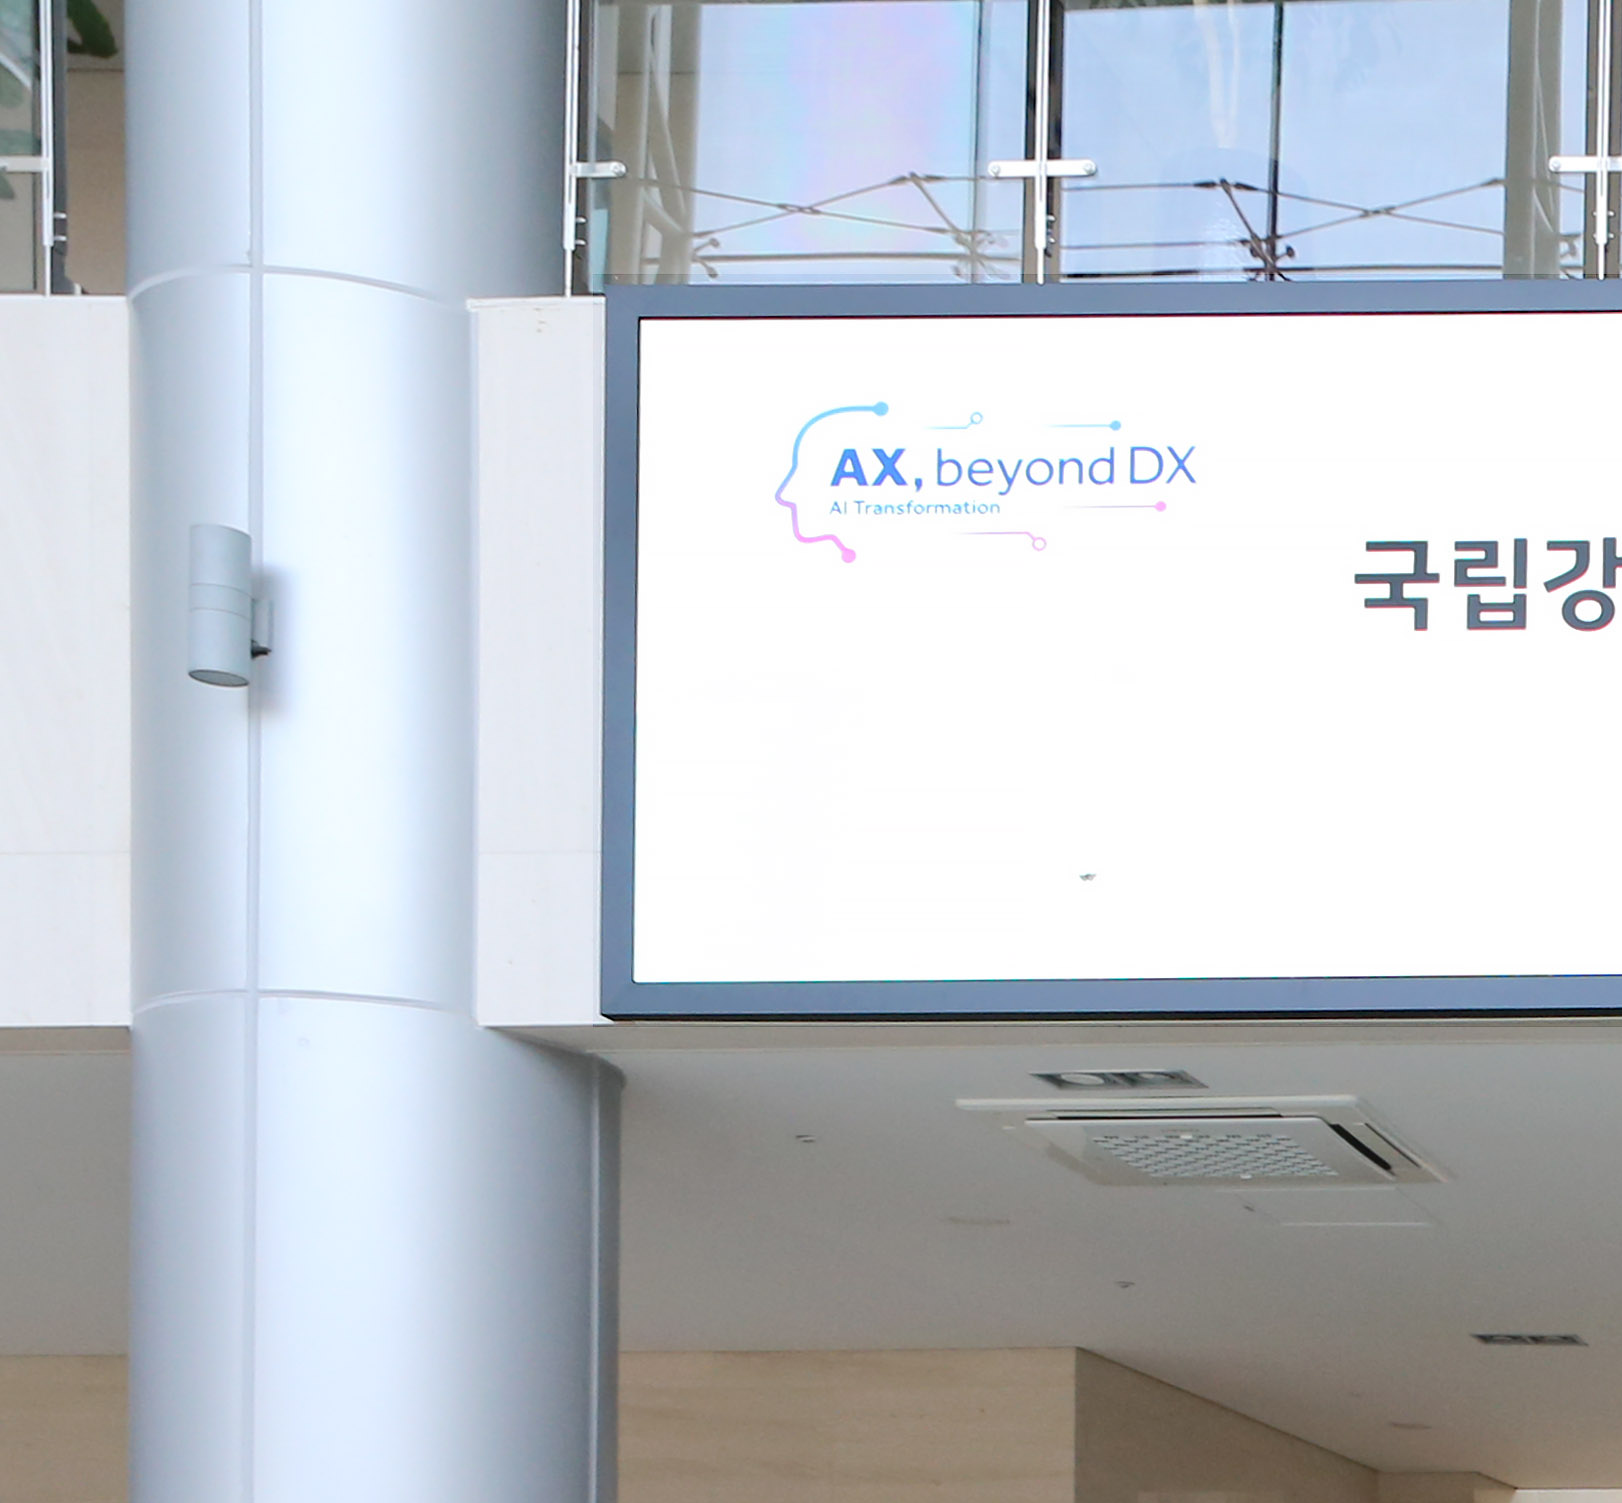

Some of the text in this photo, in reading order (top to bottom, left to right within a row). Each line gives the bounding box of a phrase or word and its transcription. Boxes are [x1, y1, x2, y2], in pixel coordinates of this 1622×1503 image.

[830, 445, 1196, 496] AX, beyond DX
[829, 499, 1000, 516] AI Transformation
